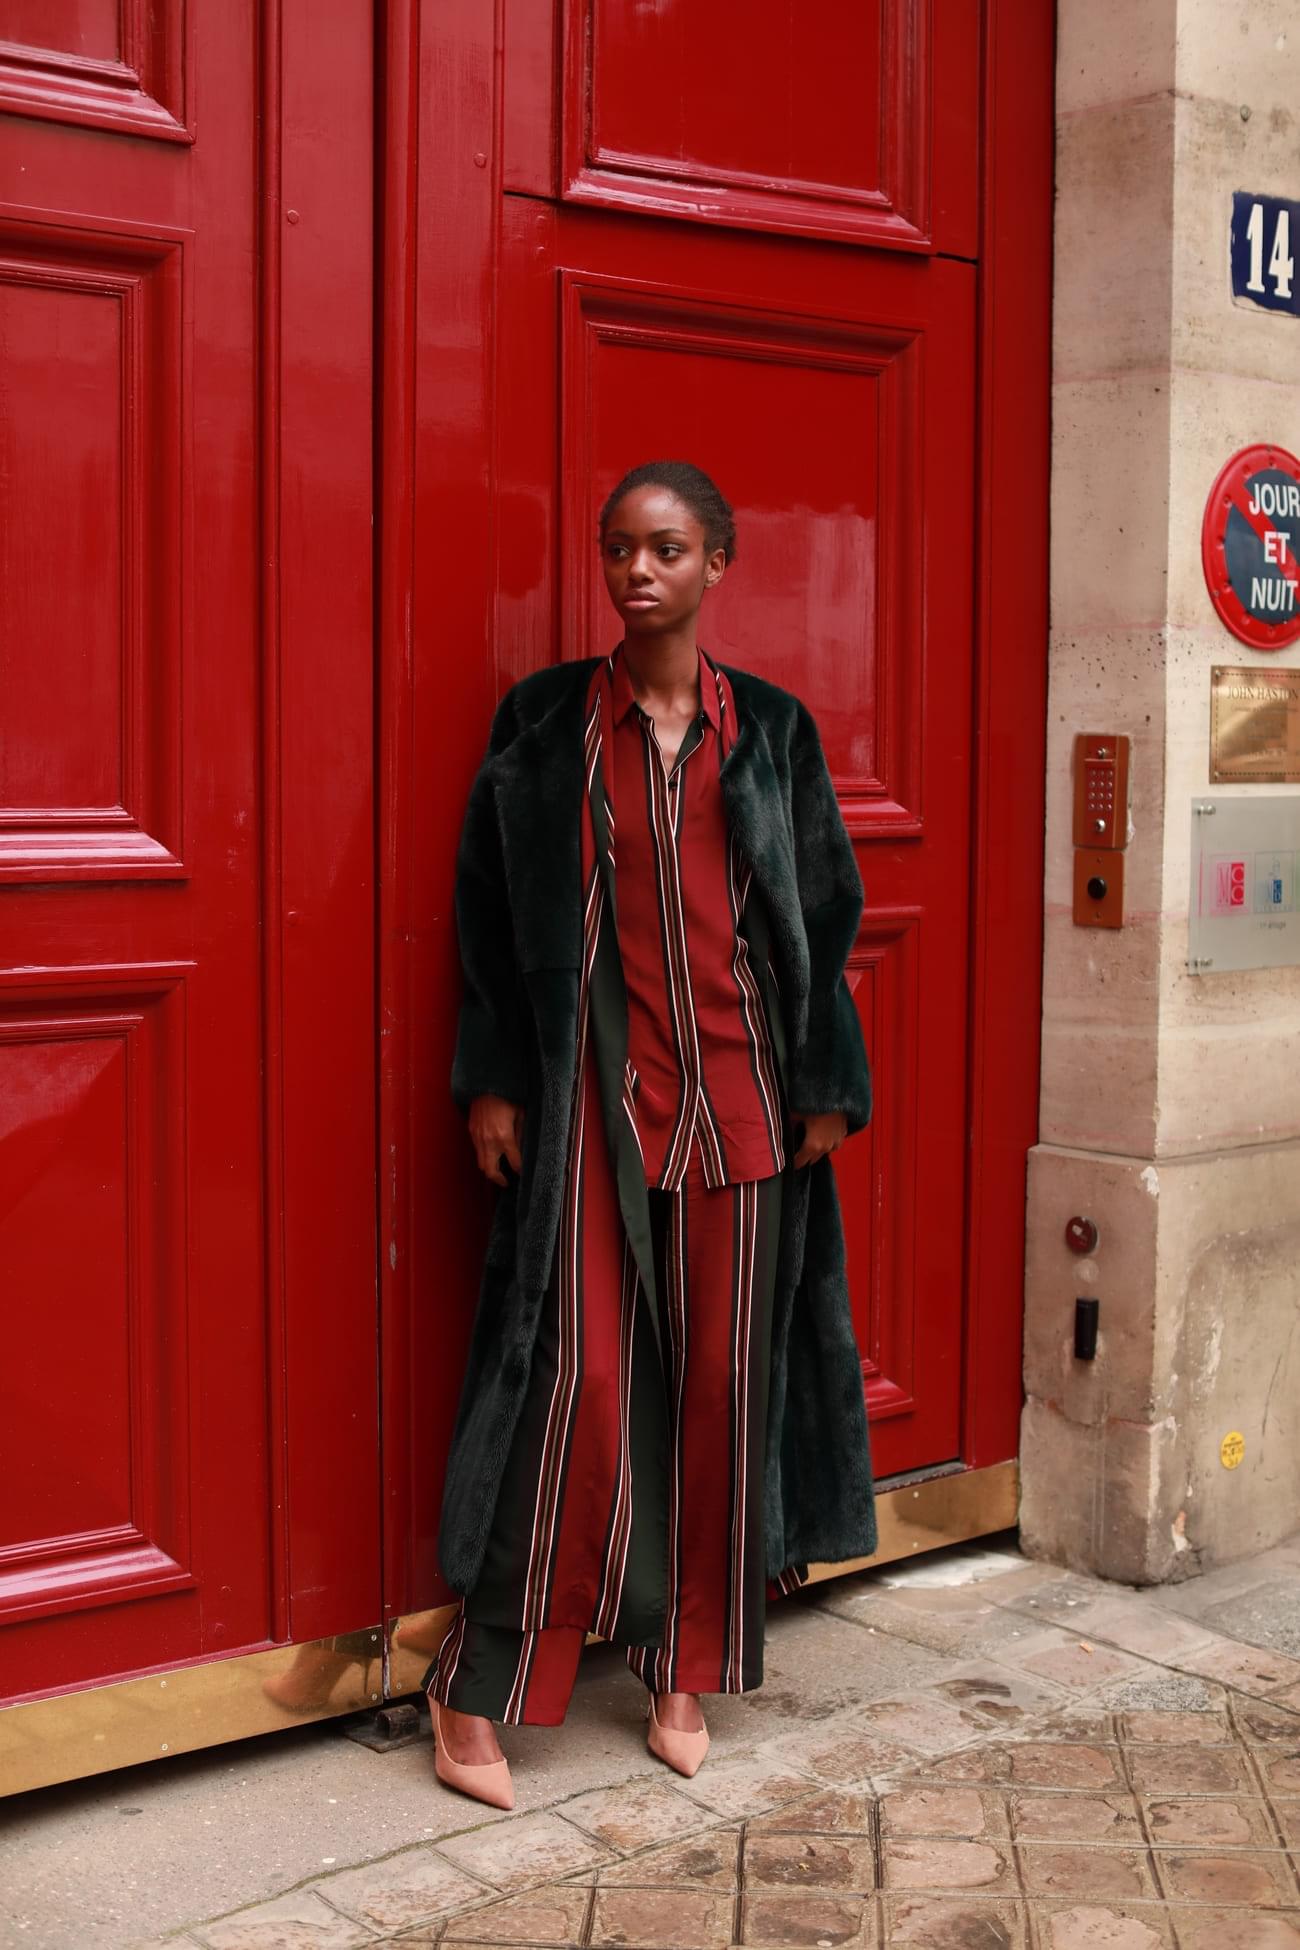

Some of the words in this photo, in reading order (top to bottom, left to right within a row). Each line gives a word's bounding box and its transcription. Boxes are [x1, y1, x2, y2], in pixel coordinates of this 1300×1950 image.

[1246, 203, 1294, 298] 14
[1248, 483, 1300, 517] JOUR
[1264, 531, 1291, 564] ET
[1251, 577, 1298, 611] NUIT
[1227, 686, 1254, 699] JOHN
